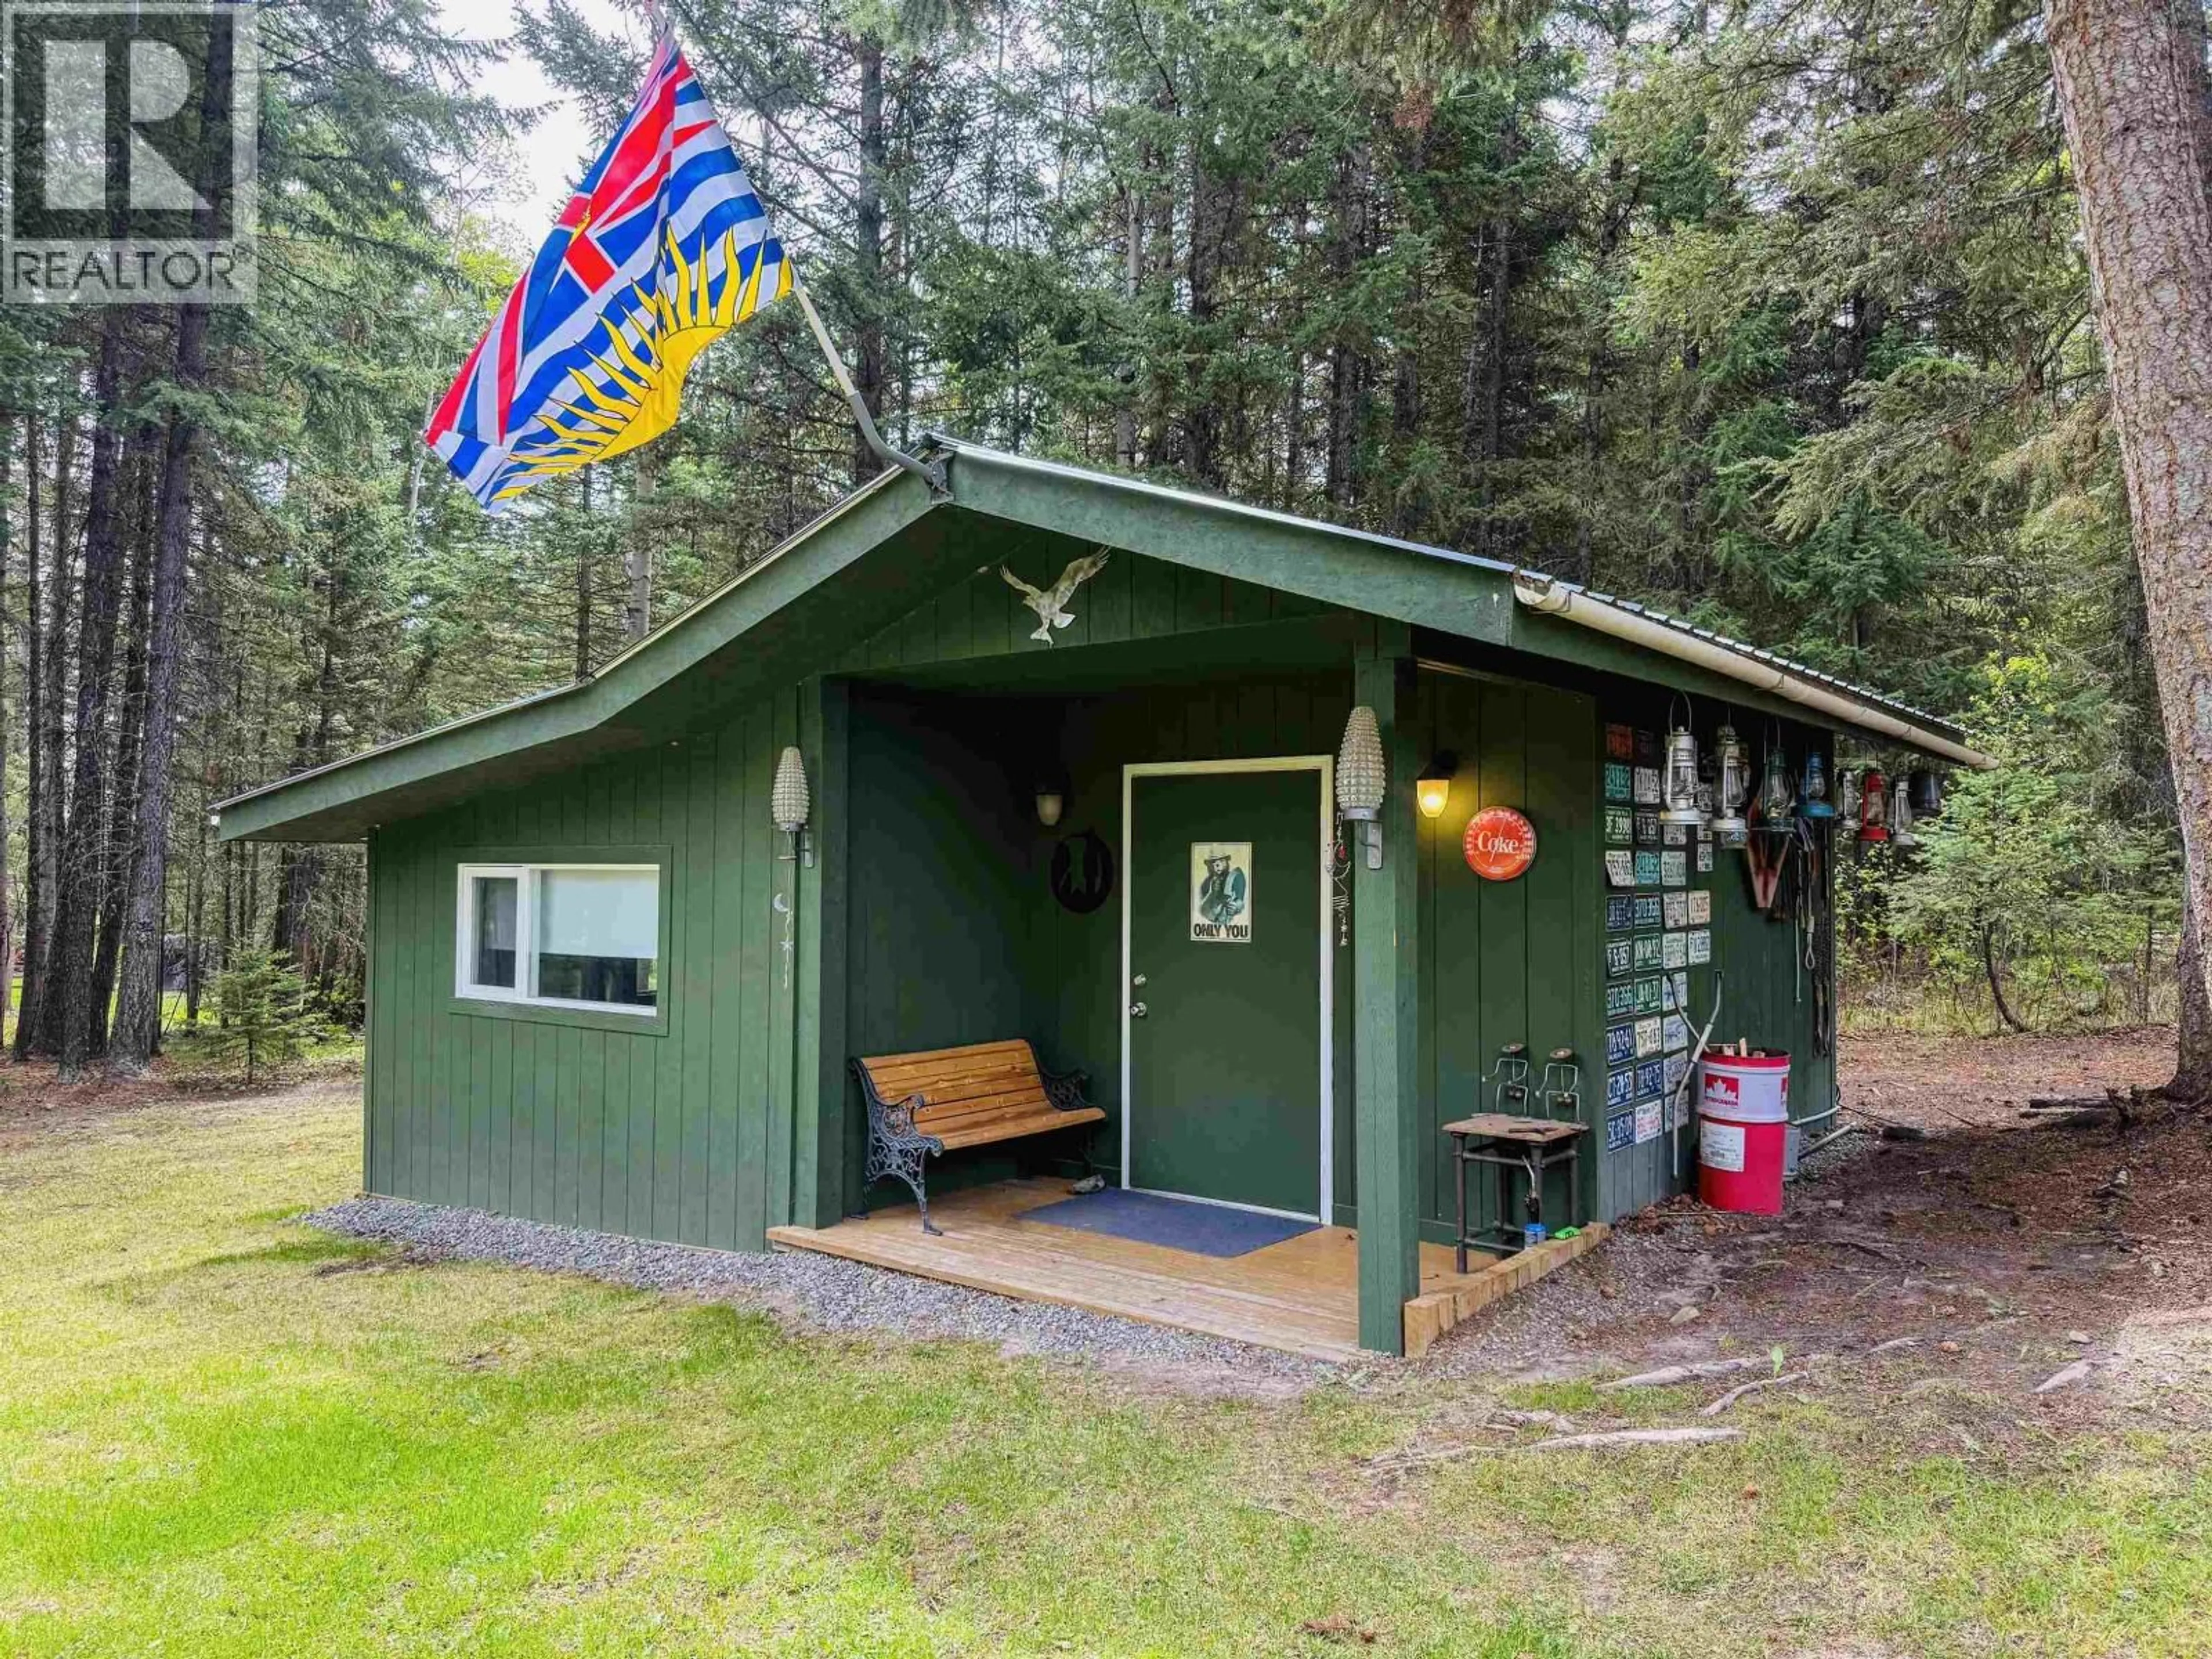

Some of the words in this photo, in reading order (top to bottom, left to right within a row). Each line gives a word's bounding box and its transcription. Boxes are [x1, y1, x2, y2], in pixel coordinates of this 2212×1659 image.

[1478, 831, 1520, 854] Coke
[1194, 923, 1221, 937] ONLY
[1225, 925, 1248, 938] YOU
